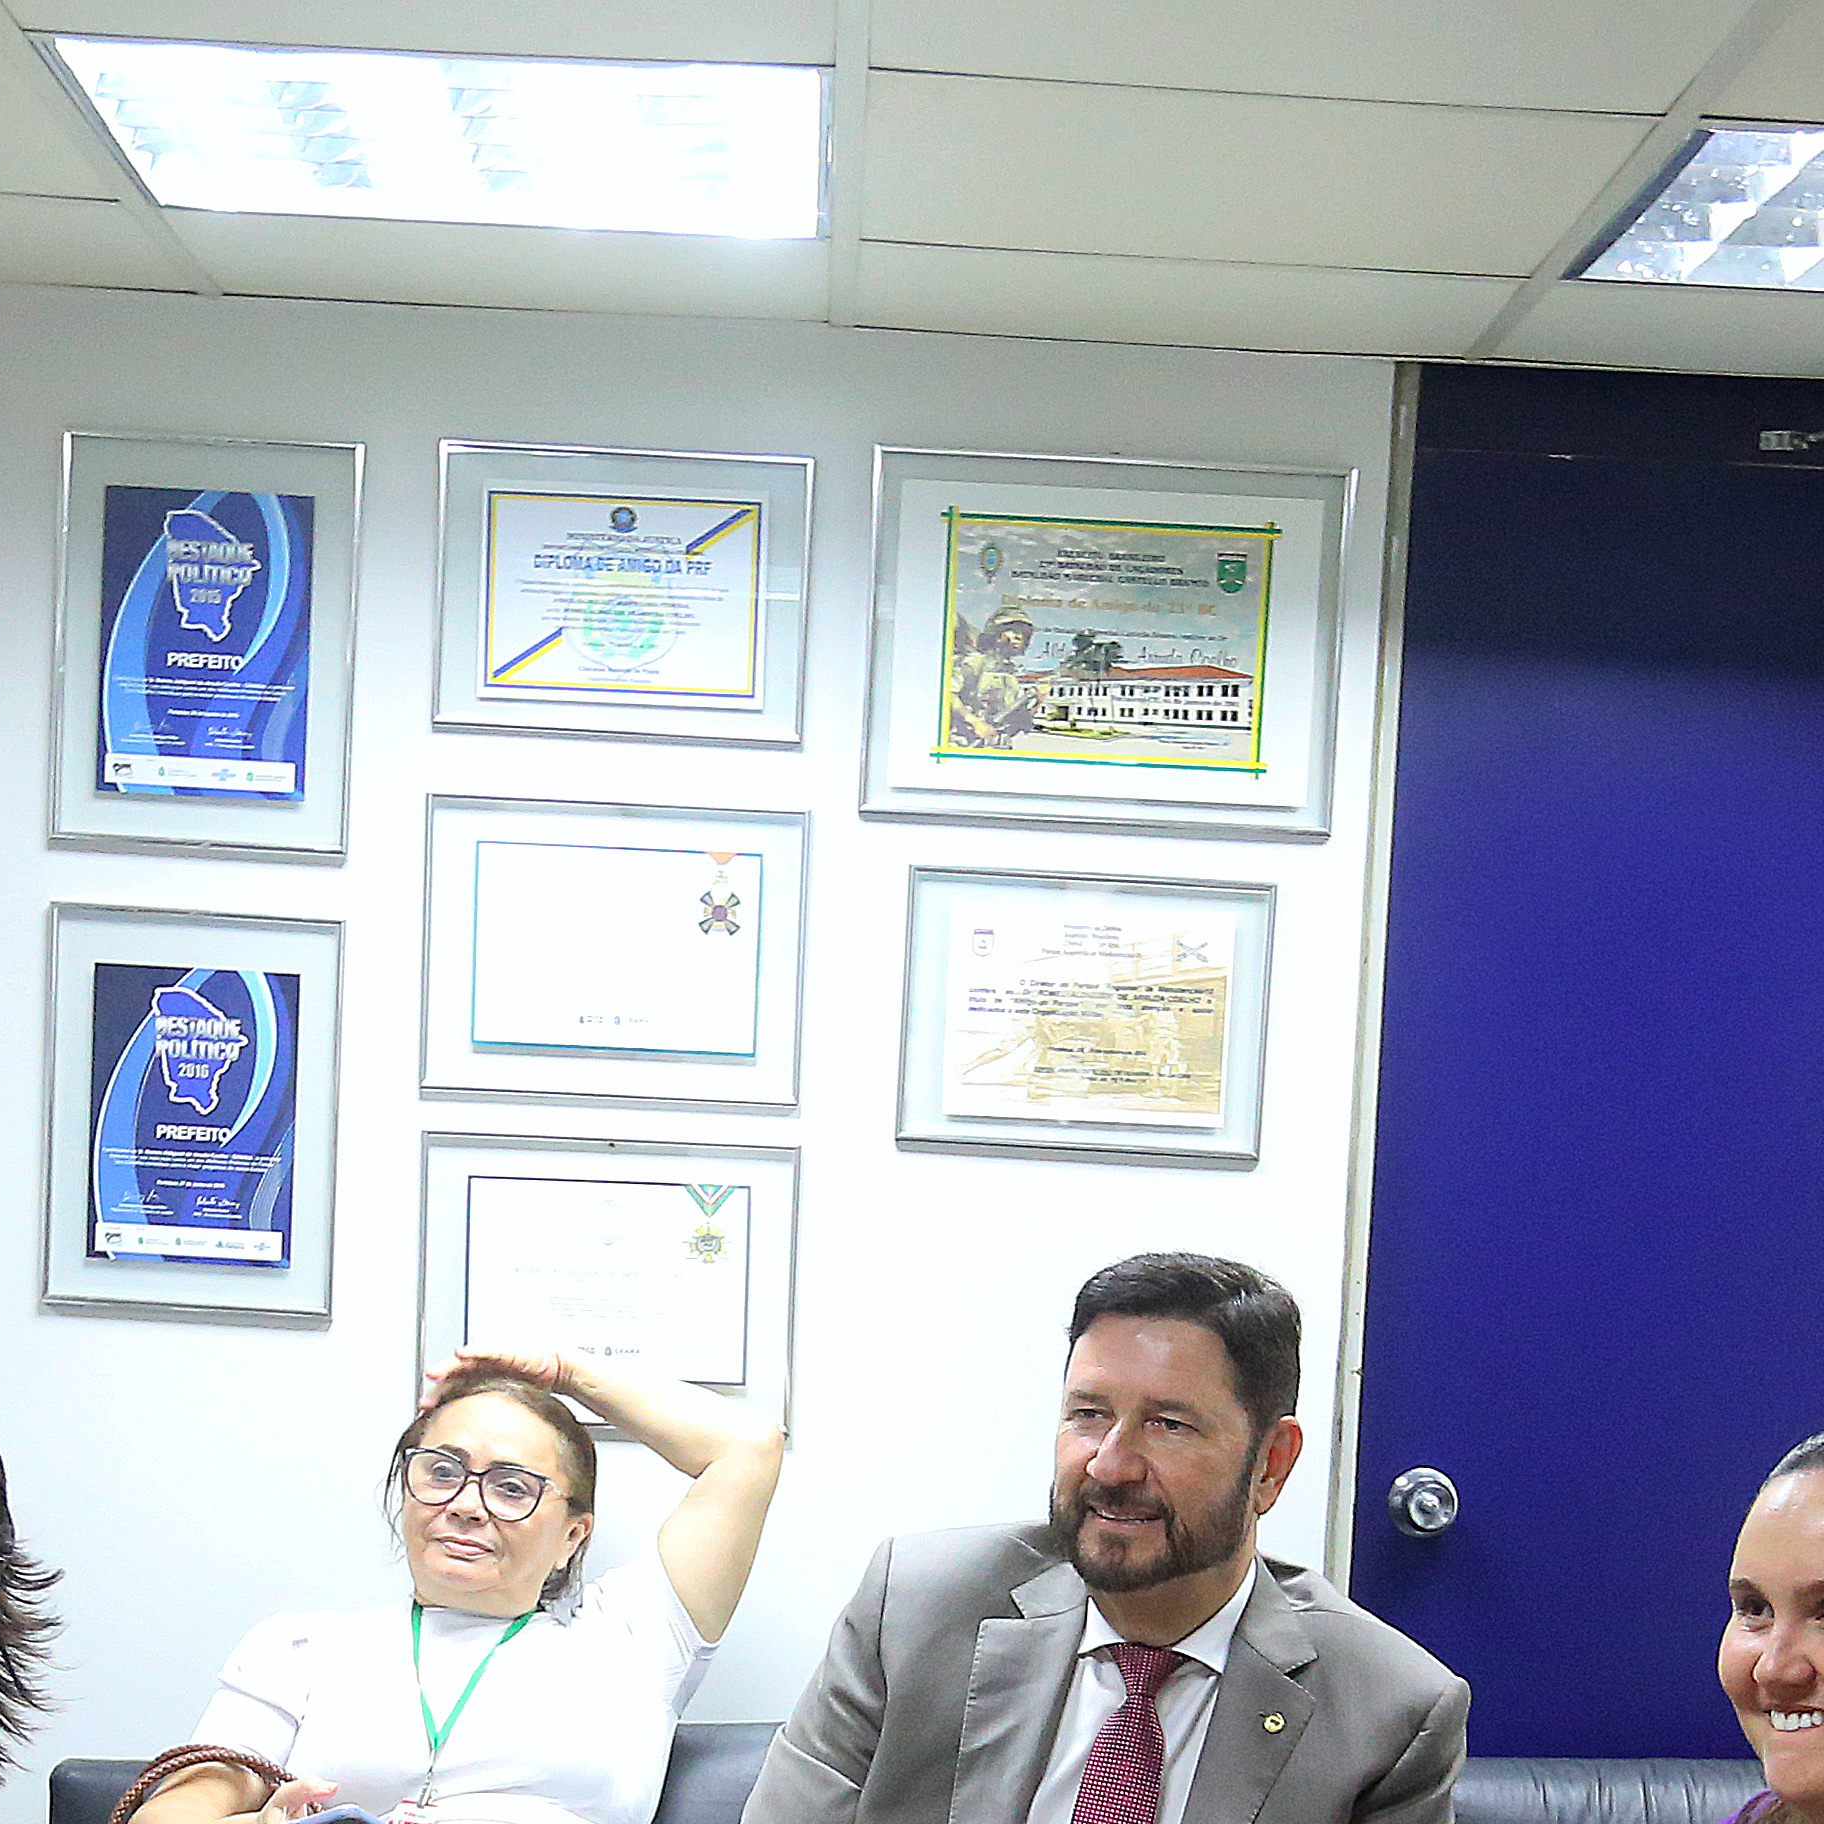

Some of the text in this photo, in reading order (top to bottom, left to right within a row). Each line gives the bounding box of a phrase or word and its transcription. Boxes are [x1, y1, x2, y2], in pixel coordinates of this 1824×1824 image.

[165, 651, 244, 672] PREFEITO
[155, 1015, 243, 1041] DESTAQUE
[154, 1038, 240, 1061] POLÍTICO
[177, 1061, 211, 1080] 2016
[155, 1123, 232, 1144] PREFEITO
